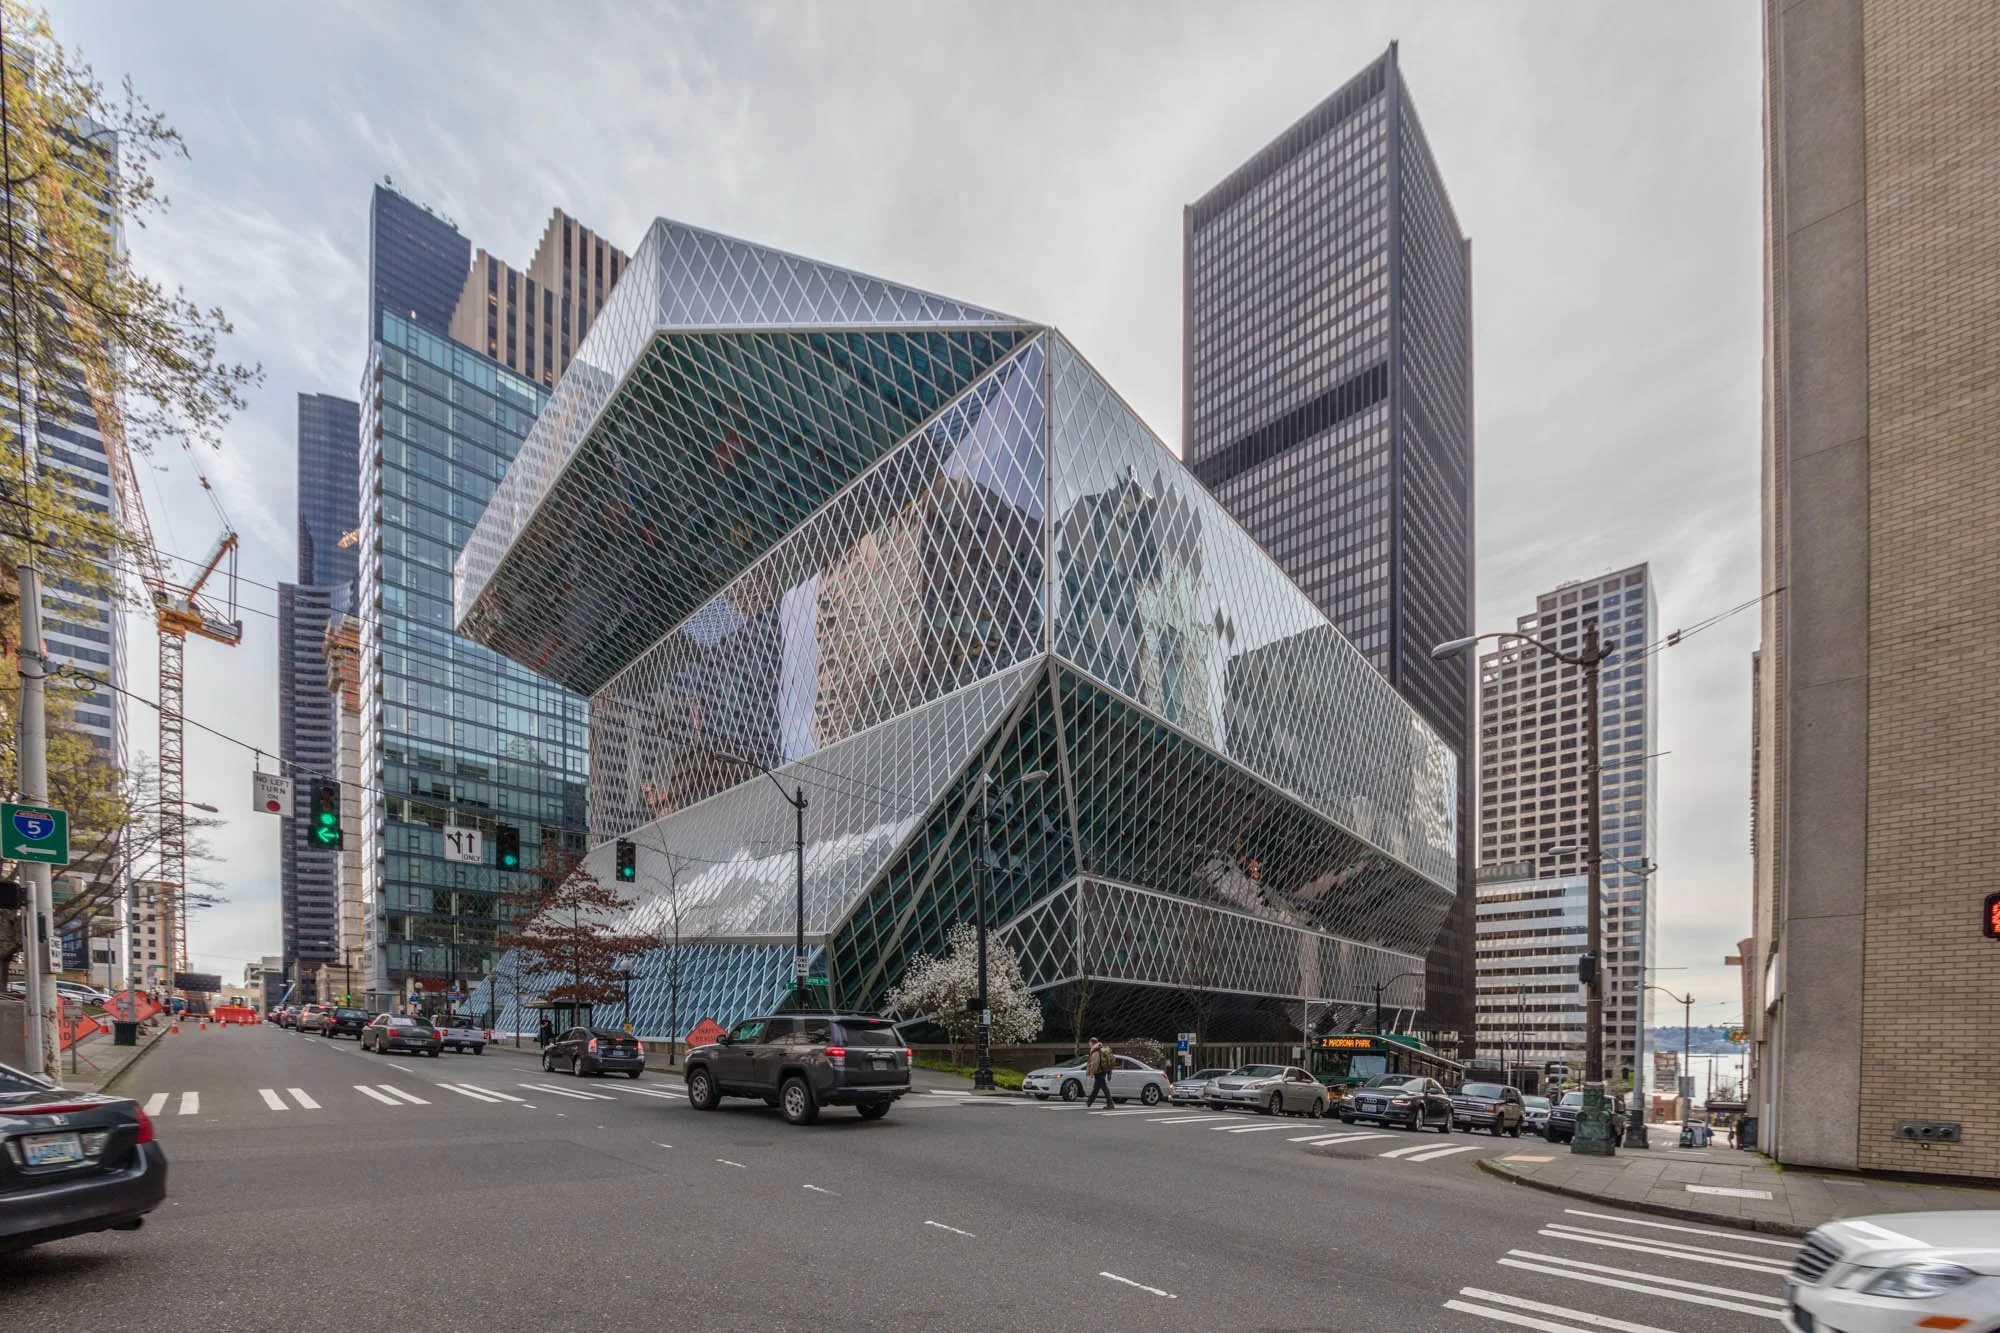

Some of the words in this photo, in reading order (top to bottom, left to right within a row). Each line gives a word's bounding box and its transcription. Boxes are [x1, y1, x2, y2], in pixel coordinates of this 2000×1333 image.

[270, 779, 288, 788] LEFT
[261, 784, 285, 794] TURN
[28, 820, 41, 834] 5
[1322, 1039, 1328, 1047] 2
[1328, 1039, 1354, 1048] MADRONA
[1355, 1039, 1370, 1048] PARK
